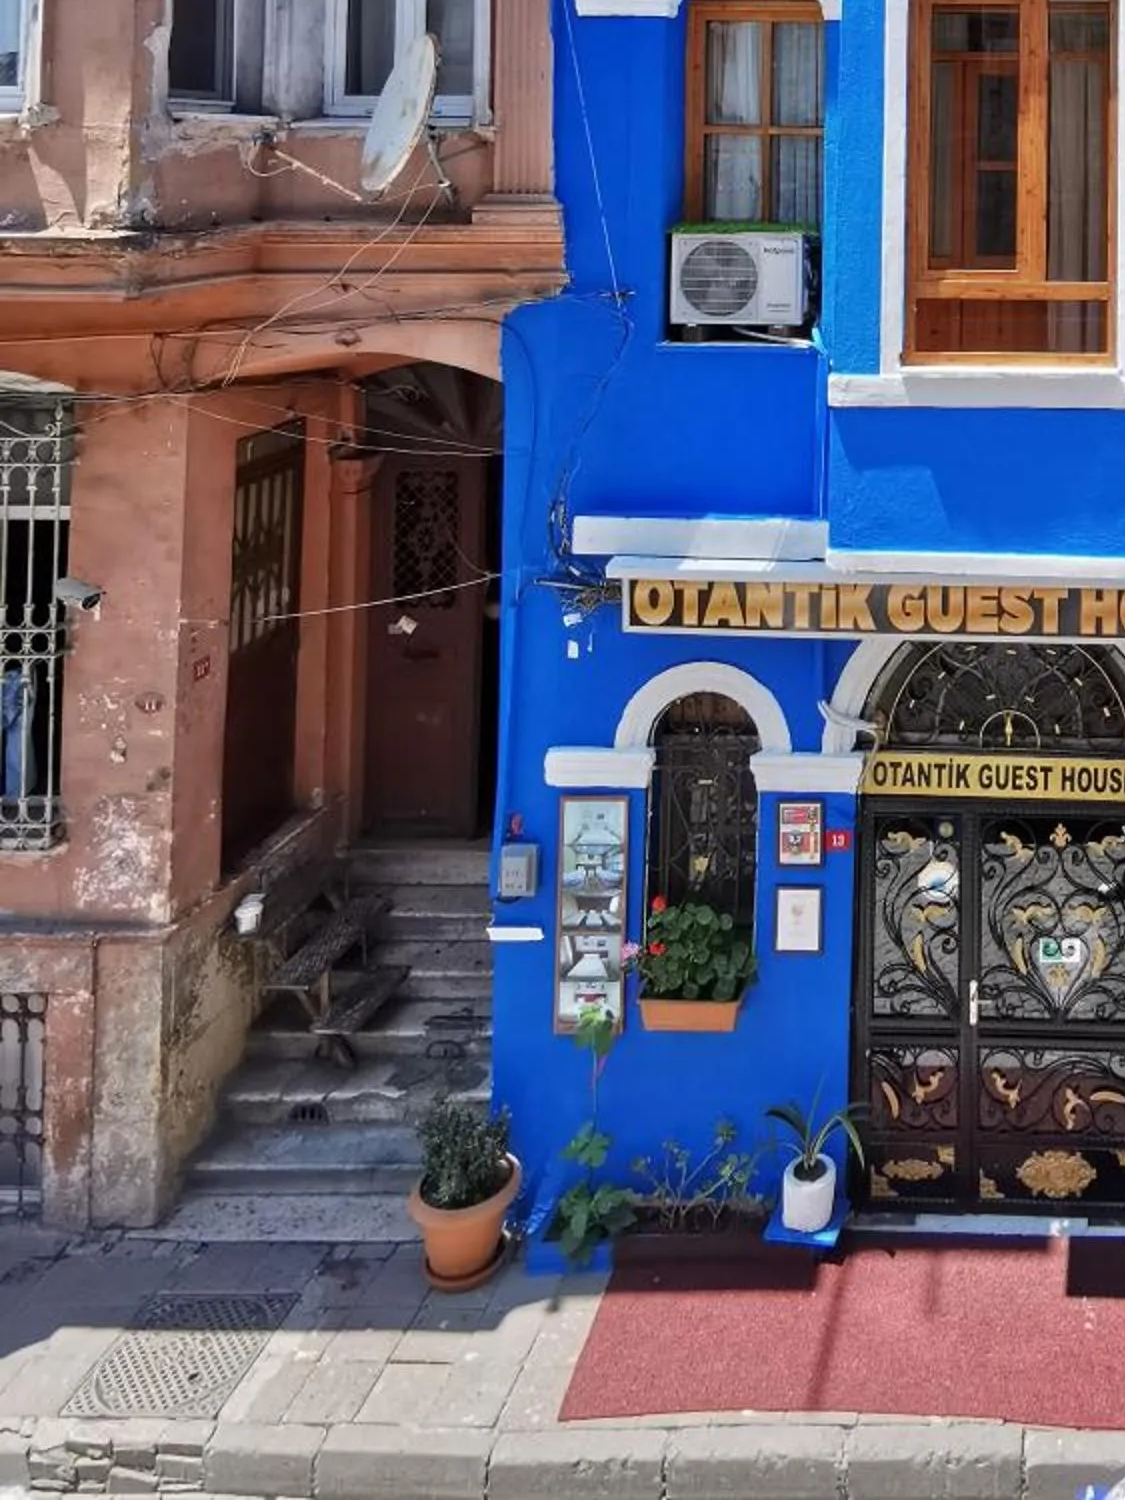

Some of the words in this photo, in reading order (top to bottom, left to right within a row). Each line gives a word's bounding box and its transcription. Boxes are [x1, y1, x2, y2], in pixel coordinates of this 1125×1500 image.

[888, 585, 1068, 634] GUEST
[978, 763, 1053, 791] GUEST
[831, 833, 846, 848] 13
